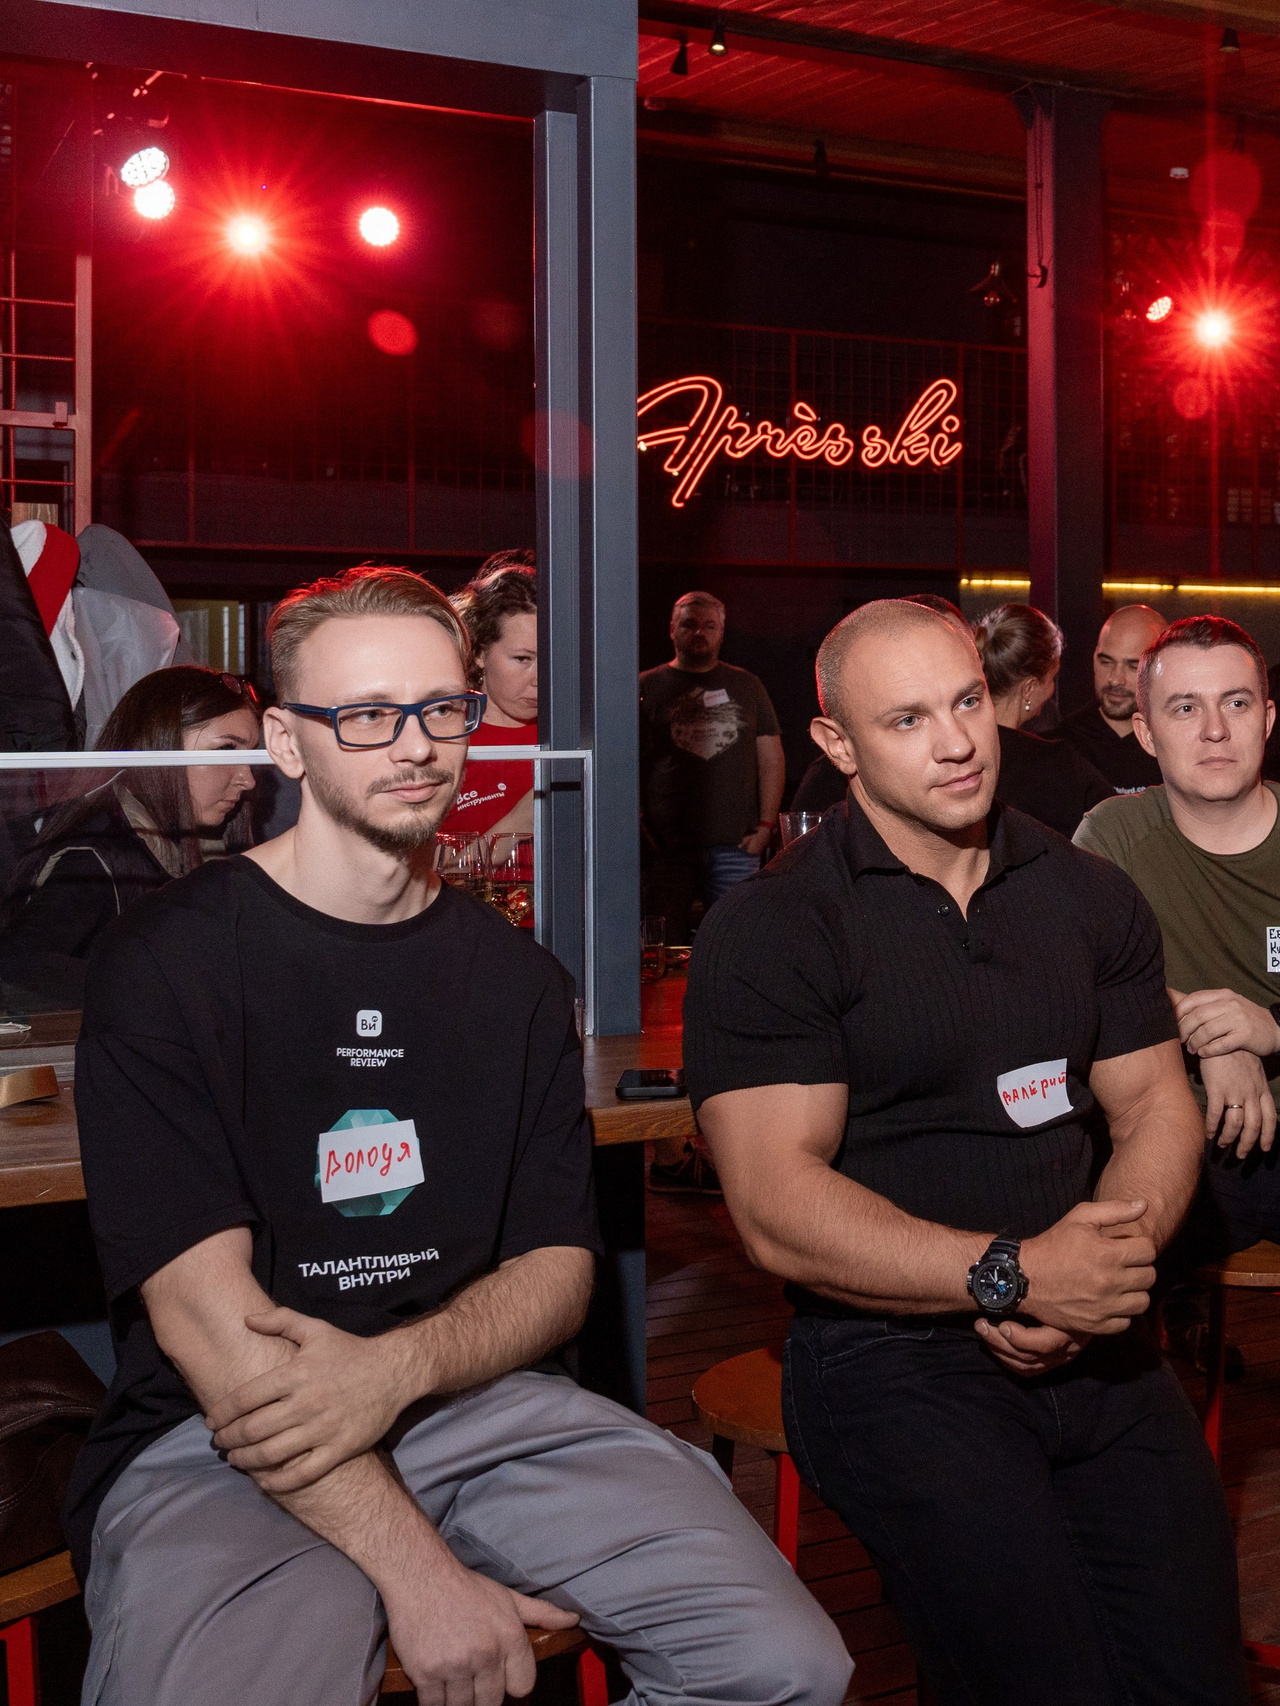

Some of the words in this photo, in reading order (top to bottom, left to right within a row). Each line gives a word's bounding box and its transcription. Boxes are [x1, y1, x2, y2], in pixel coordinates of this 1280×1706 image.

[637, 375, 853, 507] Après
[861, 378, 963, 468] ski
[336, 1047, 404, 1058] PERFORMANCE
[350, 1057, 387, 1067] REVIEW
[298, 1248, 440, 1278] ТАЛАНТЛИВЫЙ
[338, 1268, 411, 1291] ВНУТРИ
